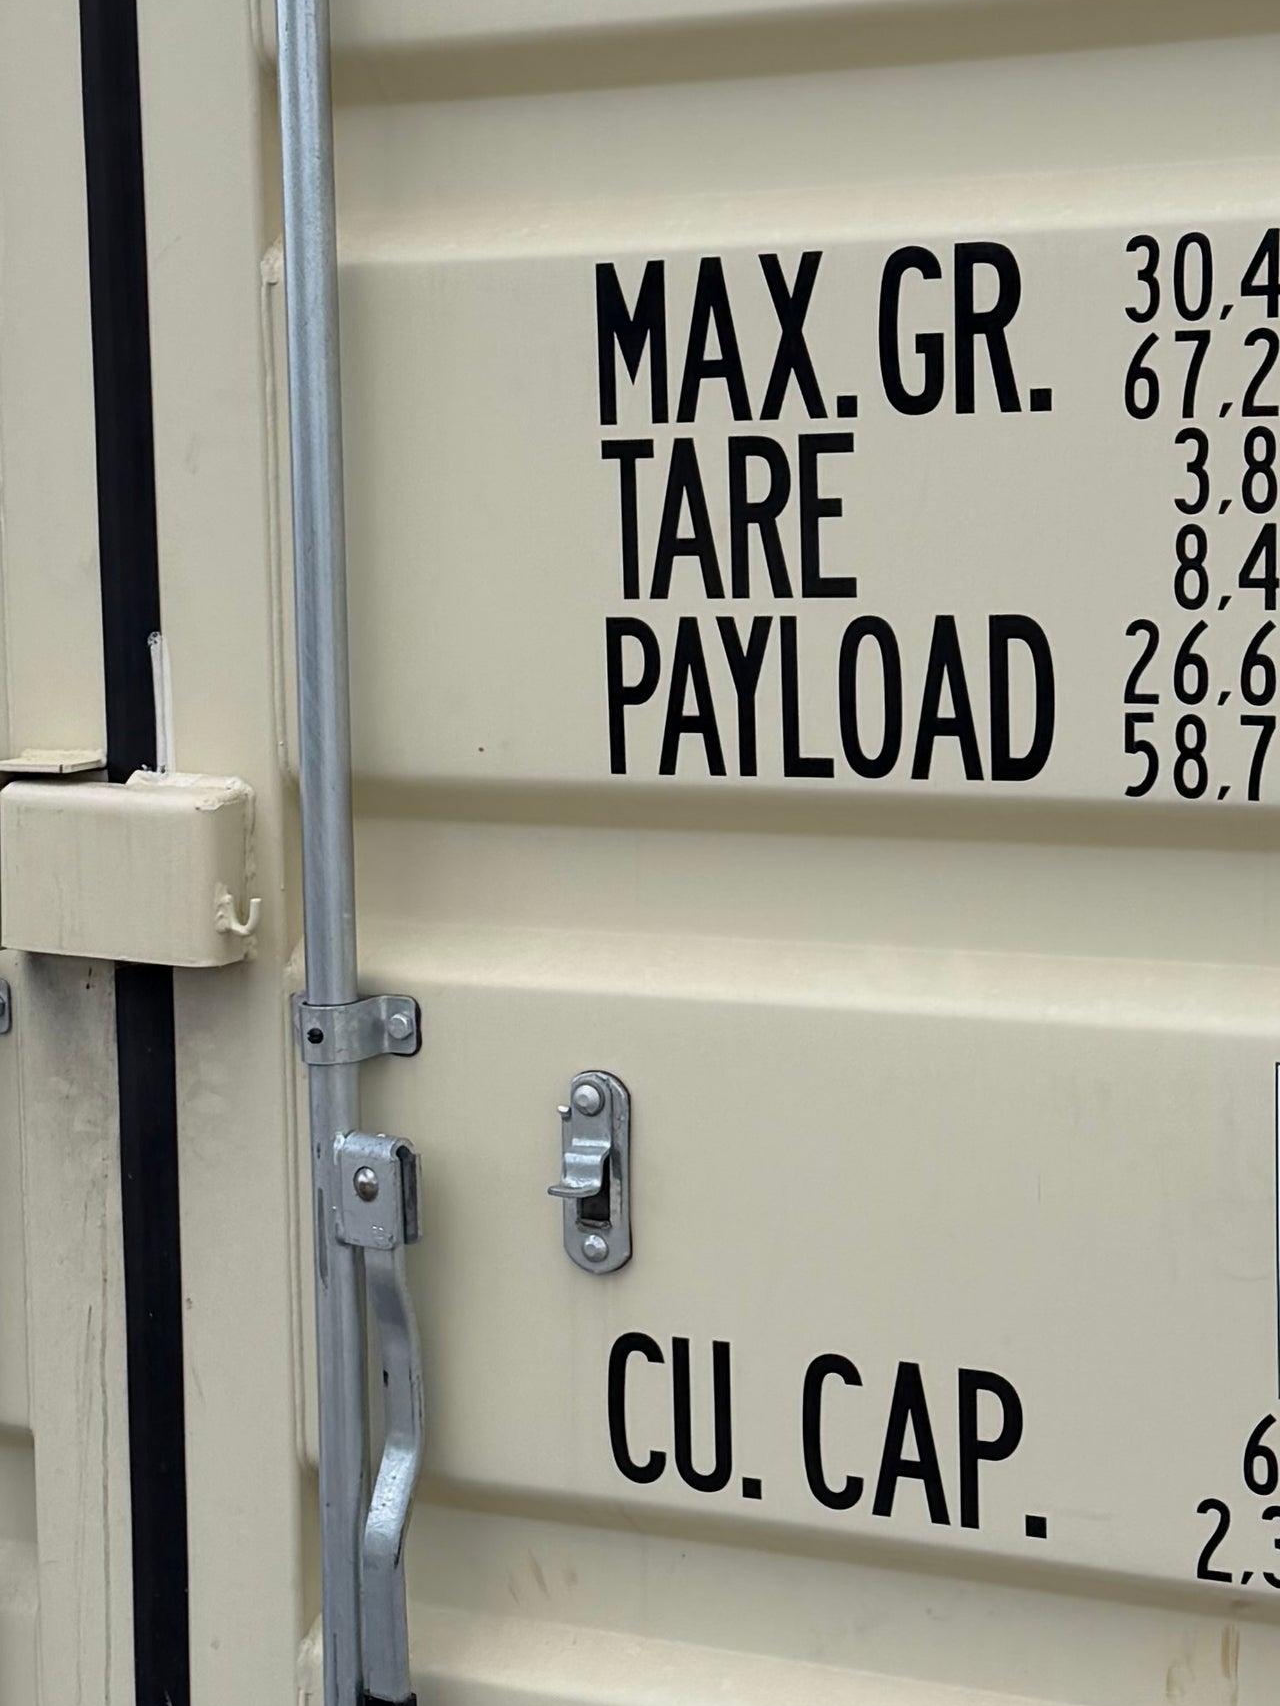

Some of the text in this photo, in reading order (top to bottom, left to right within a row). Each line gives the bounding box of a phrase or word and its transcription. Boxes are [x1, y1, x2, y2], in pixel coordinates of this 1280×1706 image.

[602, 433, 857, 599] TARE
[606, 615, 1055, 781] PAYLOAD
[608, 1332, 1046, 1538] CU. CAP.
